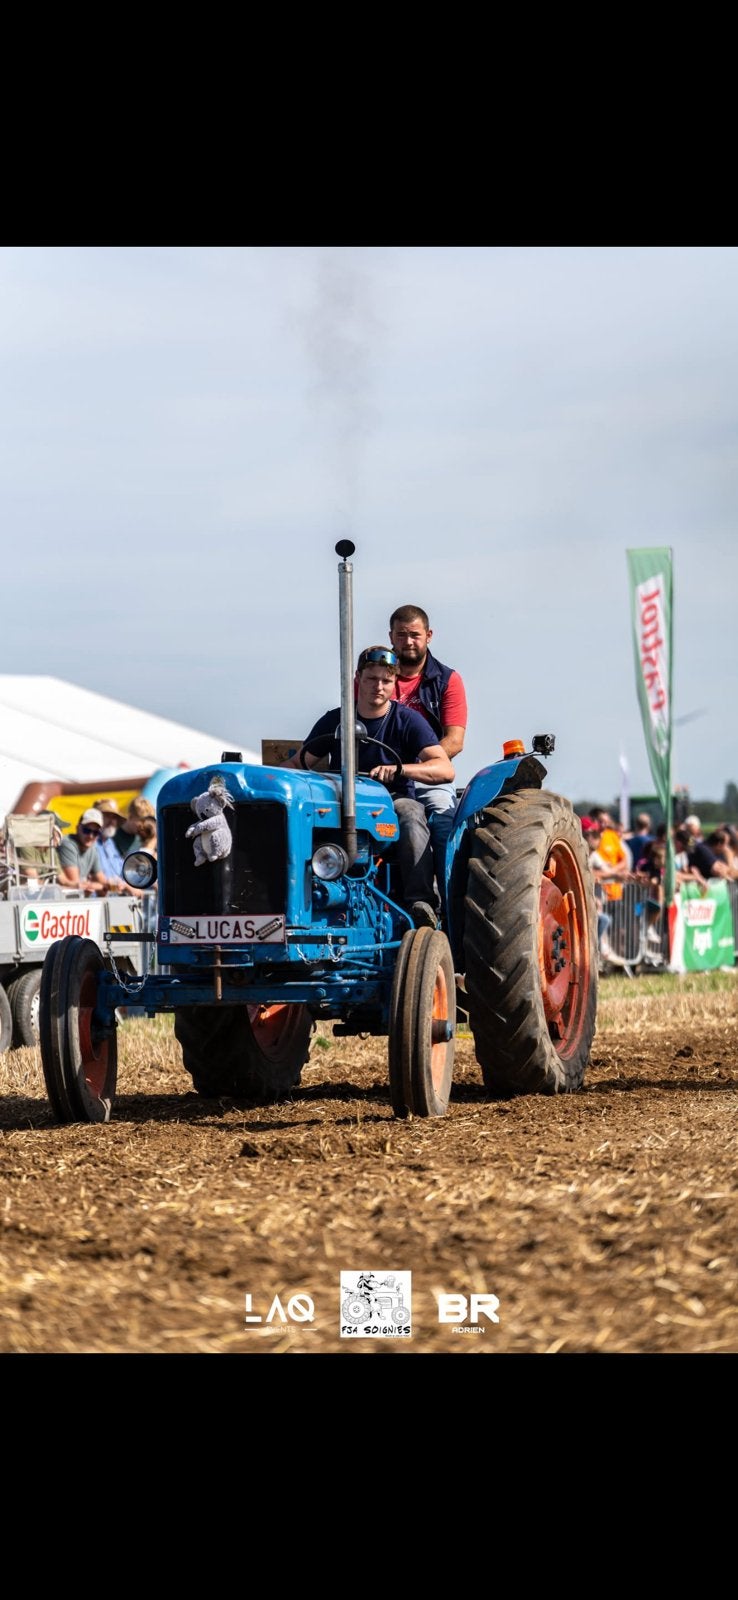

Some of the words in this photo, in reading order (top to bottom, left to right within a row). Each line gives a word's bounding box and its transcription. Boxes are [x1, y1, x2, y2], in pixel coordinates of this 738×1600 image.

[41, 910, 90, 939] Castrol
[161, 931, 168, 940] B
[195, 920, 255, 939] LUCAS
